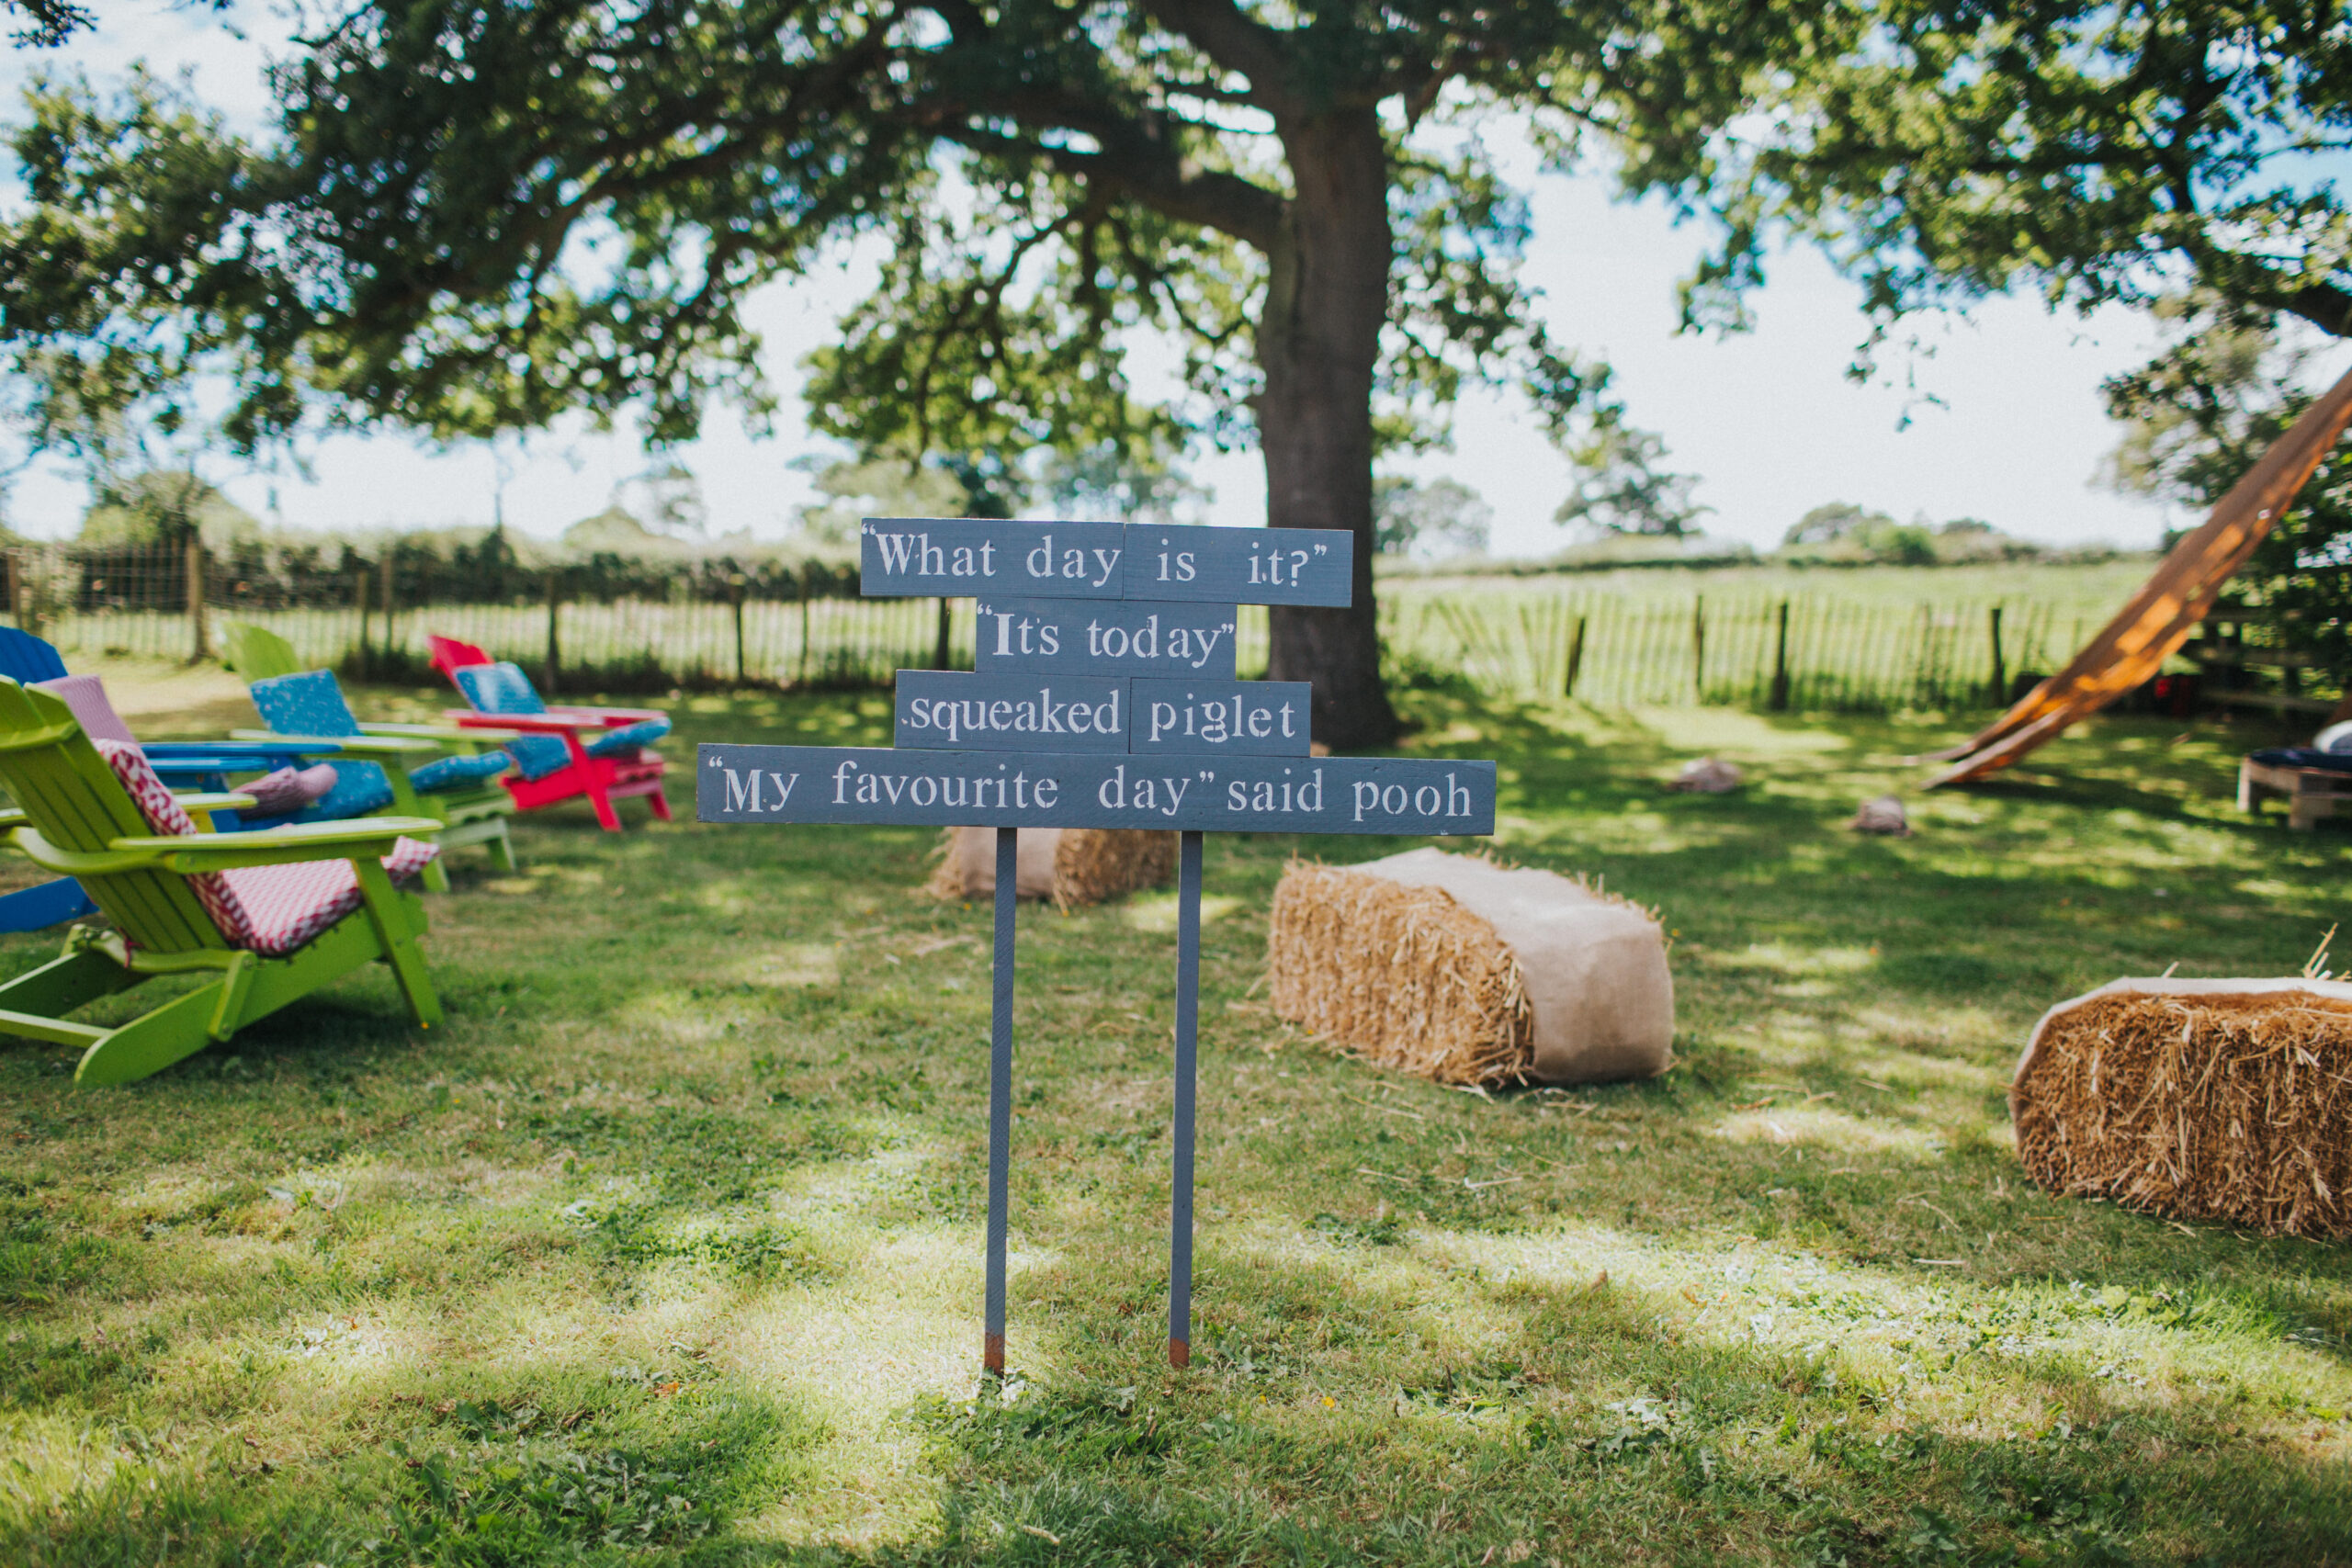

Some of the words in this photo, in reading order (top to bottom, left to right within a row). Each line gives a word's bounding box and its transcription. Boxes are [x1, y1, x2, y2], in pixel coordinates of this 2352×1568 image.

[859, 523, 996, 577] “What
[1026, 535, 1121, 588] day
[1157, 538, 1196, 581] is
[1248, 541, 1328, 587] it?”
[976, 604, 1059, 656] “It’s
[1087, 615, 1235, 669] today”
[910, 688, 1121, 742] squeaked
[1149, 693, 1295, 743] piglet
[708, 756, 799, 812] “My
[831, 760, 1057, 808] favourite
[1099, 764, 1215, 816] day”
[1227, 768, 1325, 812] said
[1352, 773, 1471, 822] pooh
